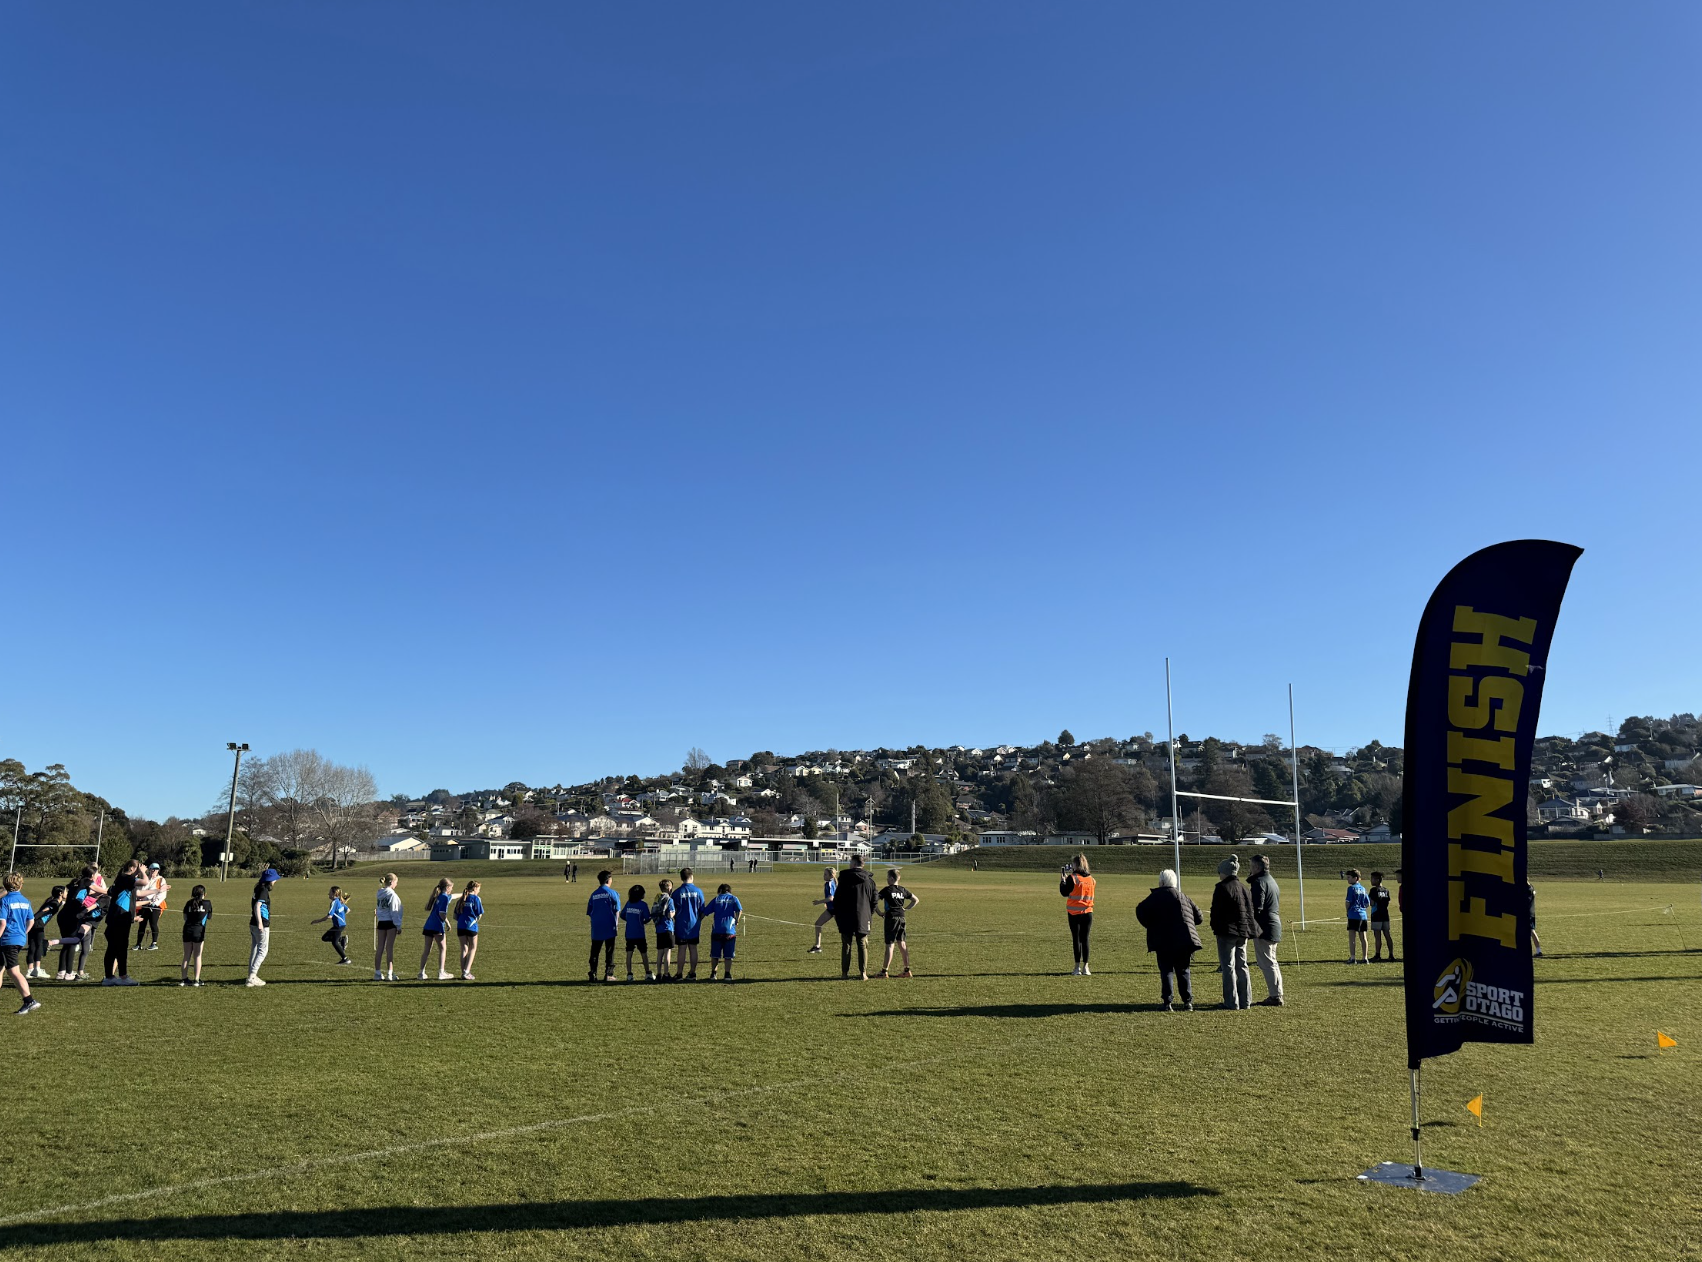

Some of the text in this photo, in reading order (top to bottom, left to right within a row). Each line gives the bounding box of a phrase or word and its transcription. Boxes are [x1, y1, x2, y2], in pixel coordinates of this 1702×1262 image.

[1447, 605, 1538, 949] FINISH
[1466, 981, 1524, 1007] SPORT
[1466, 996, 1524, 1021] OTAGO
[1459, 1014, 1489, 1025] EOPLE
[1491, 1021, 1524, 1033] ACTIVE
